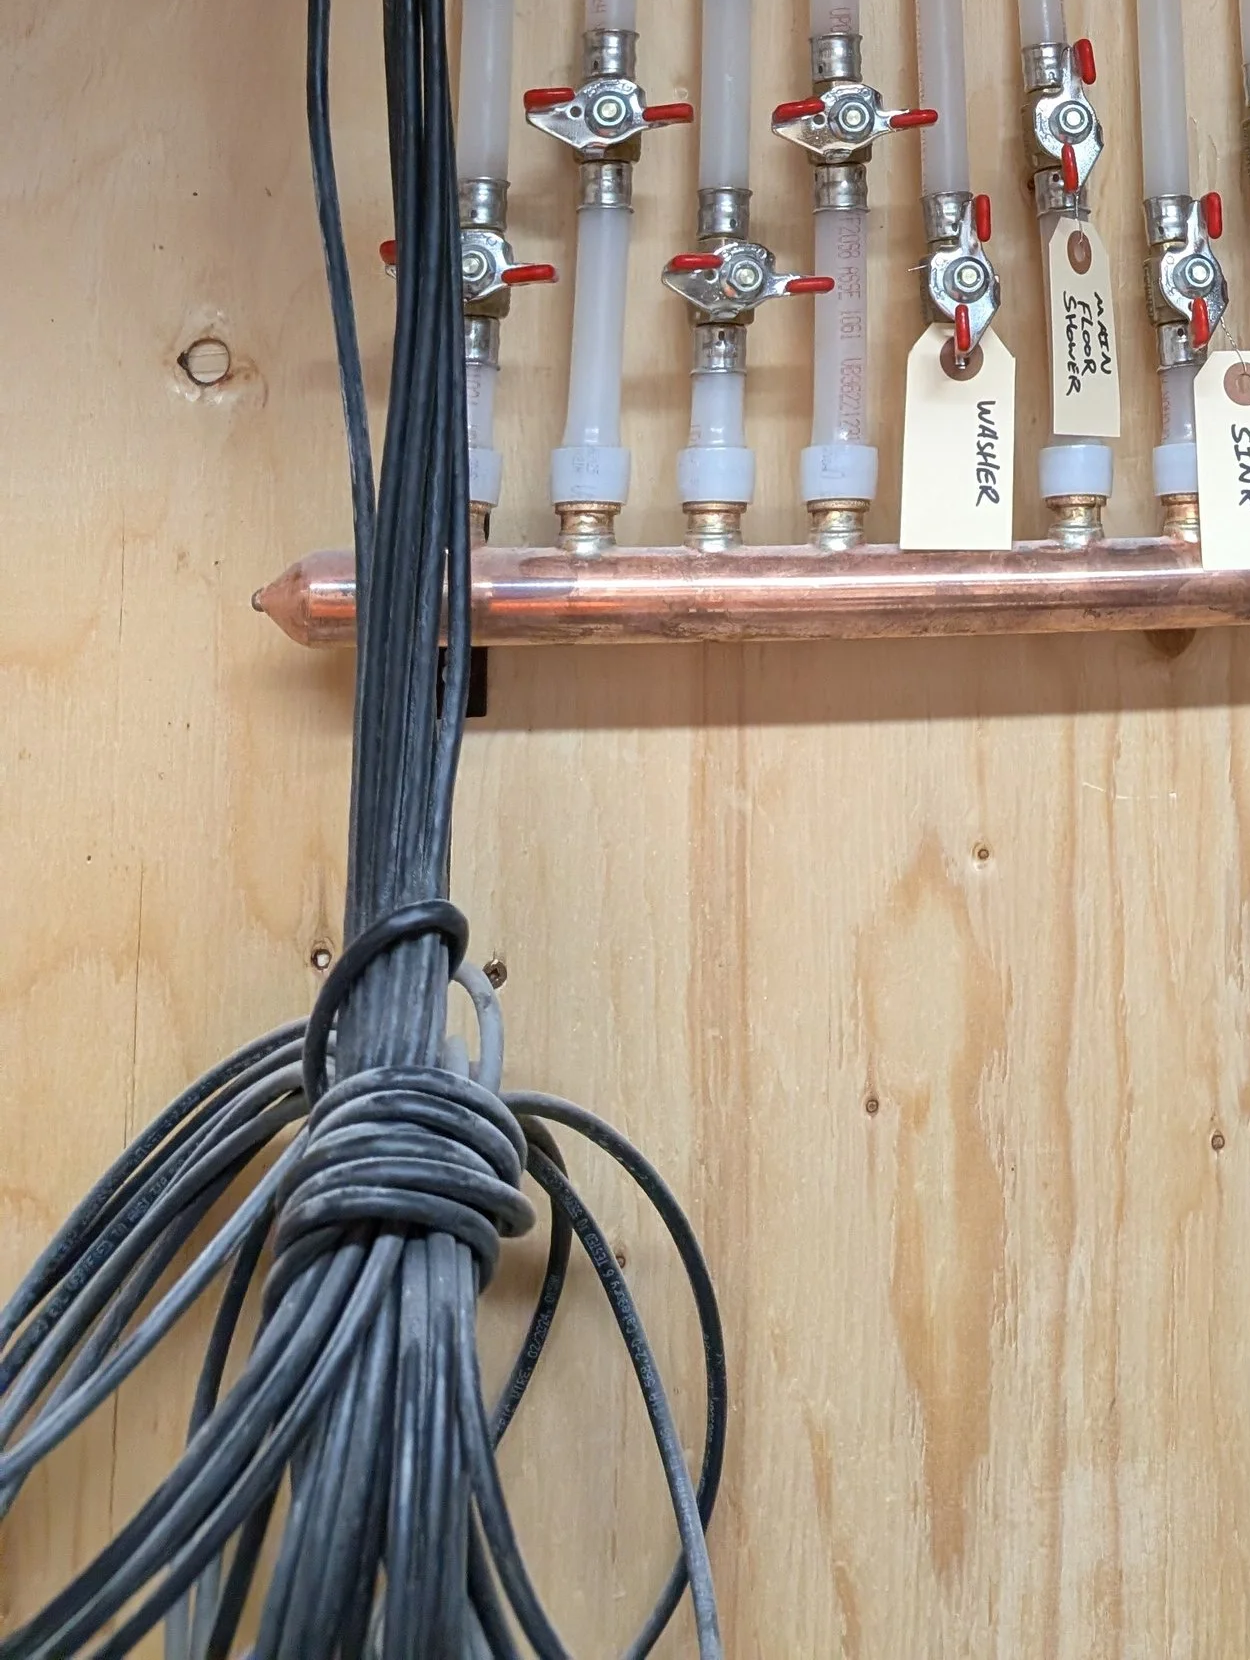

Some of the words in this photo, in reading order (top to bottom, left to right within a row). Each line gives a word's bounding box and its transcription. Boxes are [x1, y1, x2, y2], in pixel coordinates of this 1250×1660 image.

[1063, 291, 1082, 396] SHOWER
[1078, 301, 1097, 376] FLOOR
[1094, 291, 1111, 375] MAIN
[976, 401, 1000, 507] WASHER
